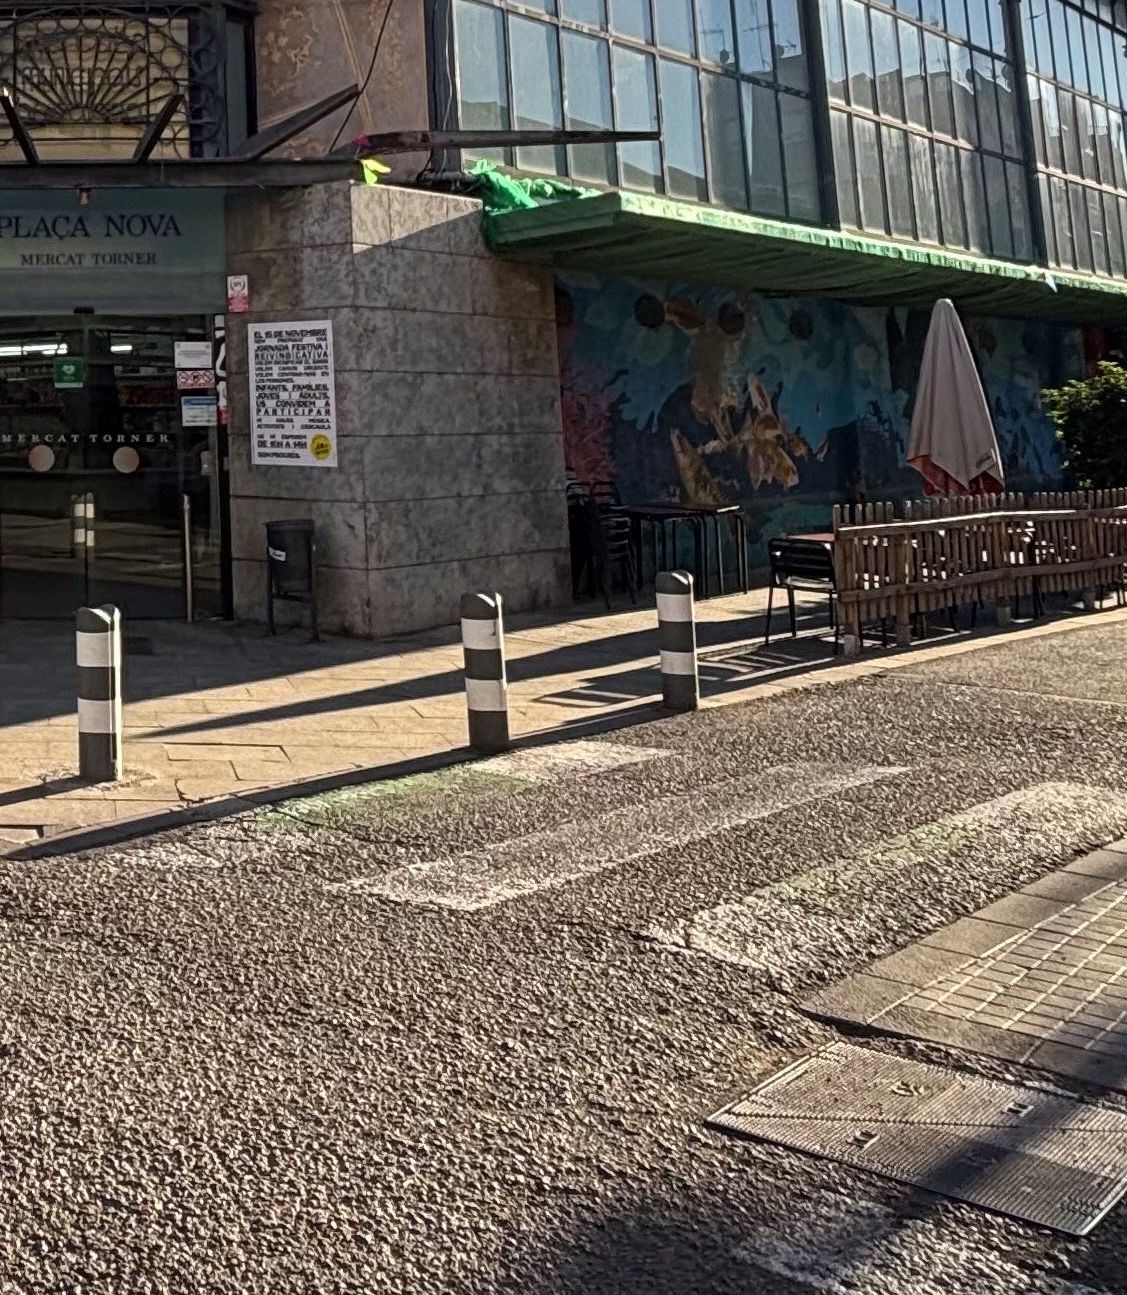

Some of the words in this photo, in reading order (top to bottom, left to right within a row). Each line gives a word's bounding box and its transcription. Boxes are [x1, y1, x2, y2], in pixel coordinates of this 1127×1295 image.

[104, 214, 183, 238] NOVA
[20, 253, 85, 266] MERCAT
[90, 252, 157, 266] TORNER
[255, 344, 289, 352] JORNADA
[292, 343, 323, 351] FESTIVA
[256, 408, 330, 416] PARTICIPAR
[1, 433, 80, 443] MERCAT
[89, 433, 170, 443] TORNER
[258, 440, 267, 448] DE
[284, 440, 290, 448] A
